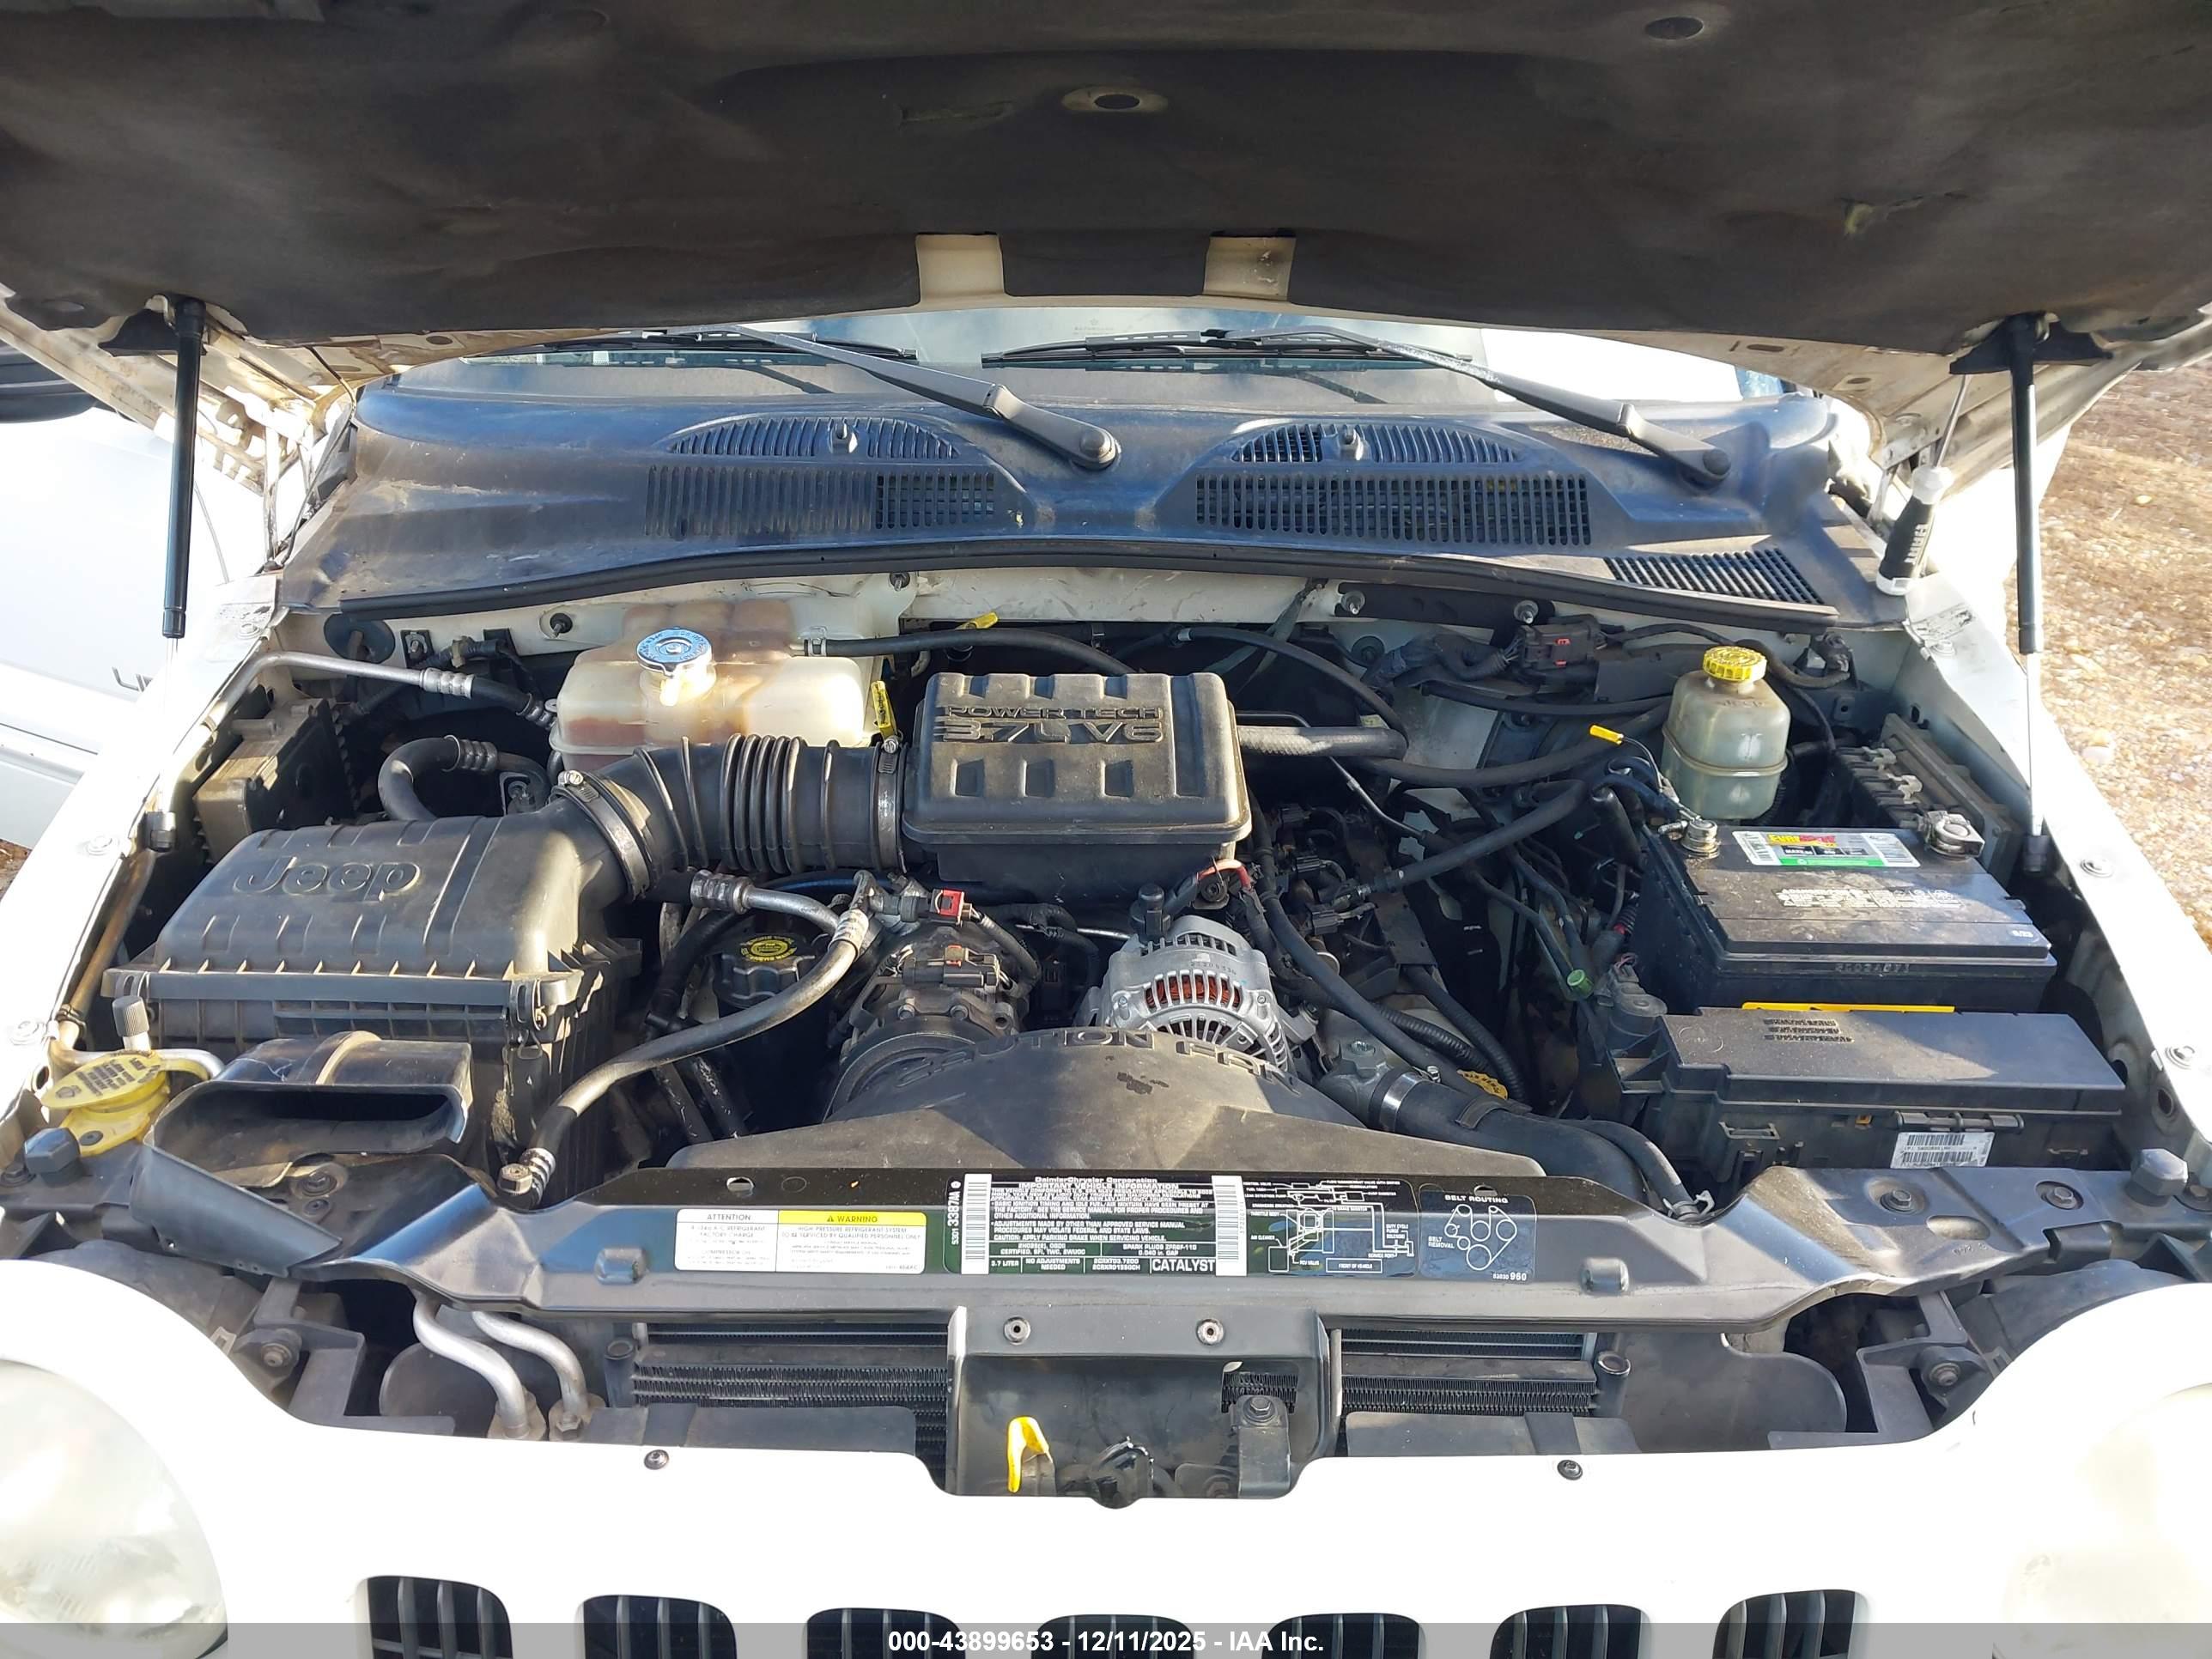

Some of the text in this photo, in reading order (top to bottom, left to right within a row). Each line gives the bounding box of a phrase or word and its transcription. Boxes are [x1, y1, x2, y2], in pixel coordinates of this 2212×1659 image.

[1084, 721, 1163, 743] V6
[233, 856, 421, 902] Jeep
[1468, 1195, 1509, 1204] ROUTING
[1152, 1259, 1215, 1272] CATALYST
[1510, 1272, 1527, 1281] 960
